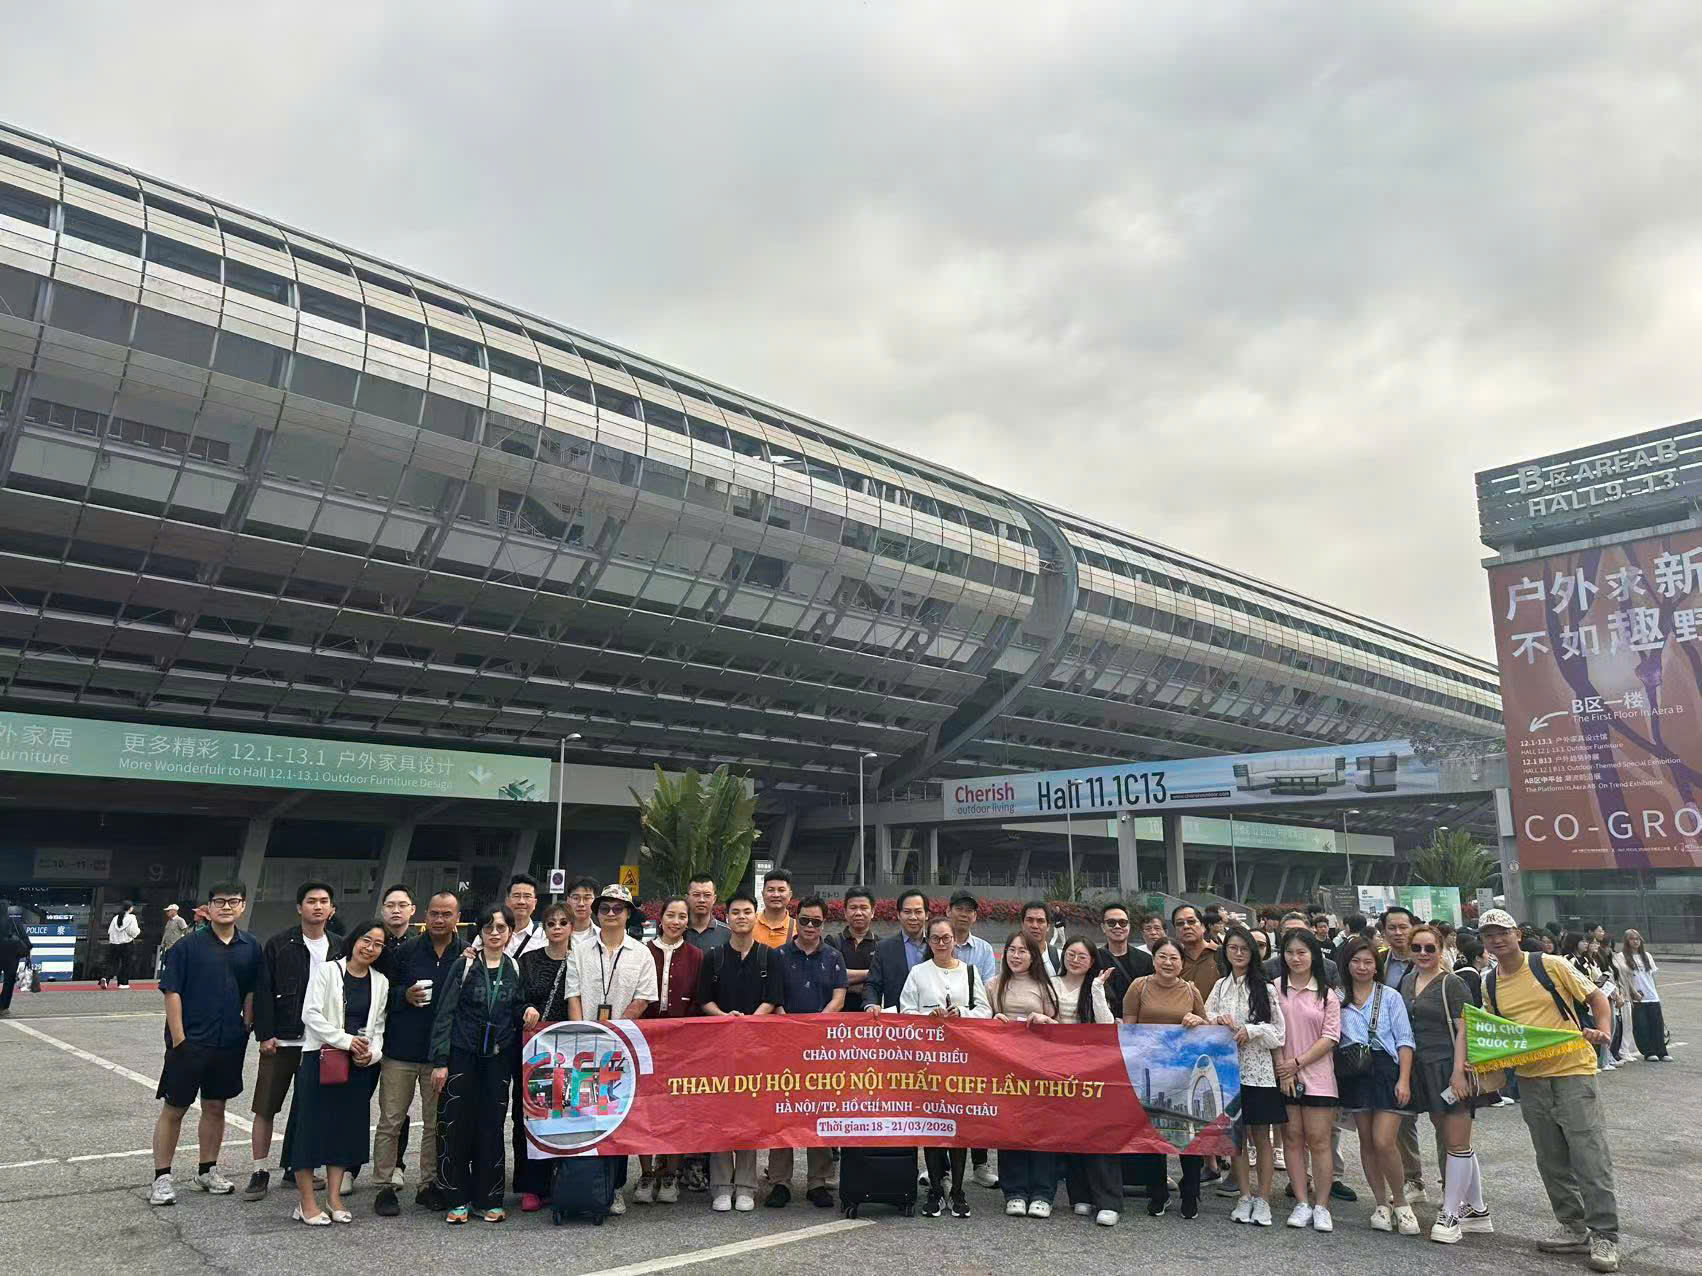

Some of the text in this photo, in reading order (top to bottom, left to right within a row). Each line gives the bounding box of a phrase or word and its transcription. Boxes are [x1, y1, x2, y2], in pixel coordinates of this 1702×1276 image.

[1572, 715, 1590, 723] The
[1591, 712, 1613, 721] First
[1613, 710, 1638, 719] Floor
[1676, 704, 1684, 713] B
[121, 732, 455, 776] 更多精彩 12.1-13.1 户外家具设计
[119, 758, 152, 771] More
[228, 766, 241, 776] to
[243, 767, 267, 778] Hall
[270, 768, 320, 782] 12.1-13.1
[322, 772, 369, 785] Outdoor
[370, 774, 418, 788] Furniture
[955, 782, 1014, 804] Cherish
[1086, 771, 1167, 807] 11.1C13
[957, 802, 1015, 815] outdoor living
[26, 926, 48, 934] POLICE
[826, 1022, 945, 1043] HỘI CHỢ QUỐC TẾ
[803, 1046, 837, 1061] CHÀO
[838, 1045, 877, 1060] MỪNG
[879, 1046, 913, 1061] ĐOÀN
[915, 1050, 937, 1065] ĐẠI
[667, 1067, 1105, 1098] THAM DỰ HỘI CHỢ NỘI THẤT CIFF LẦN THỨ 57
[775, 1099, 793, 1114] HÀ
[842, 1097, 859, 1112] HỒ
[861, 1098, 880, 1112] CHÍ
[881, 1101, 913, 1112] MINH
[922, 1099, 964, 1115] QUẢNG
[965, 1102, 998, 1117] CHÂU
[819, 1120, 843, 1132] Thời
[844, 1121, 870, 1134] gian:
[871, 1121, 883, 1131] 18
[891, 1120, 954, 1133] 21/03/2026
